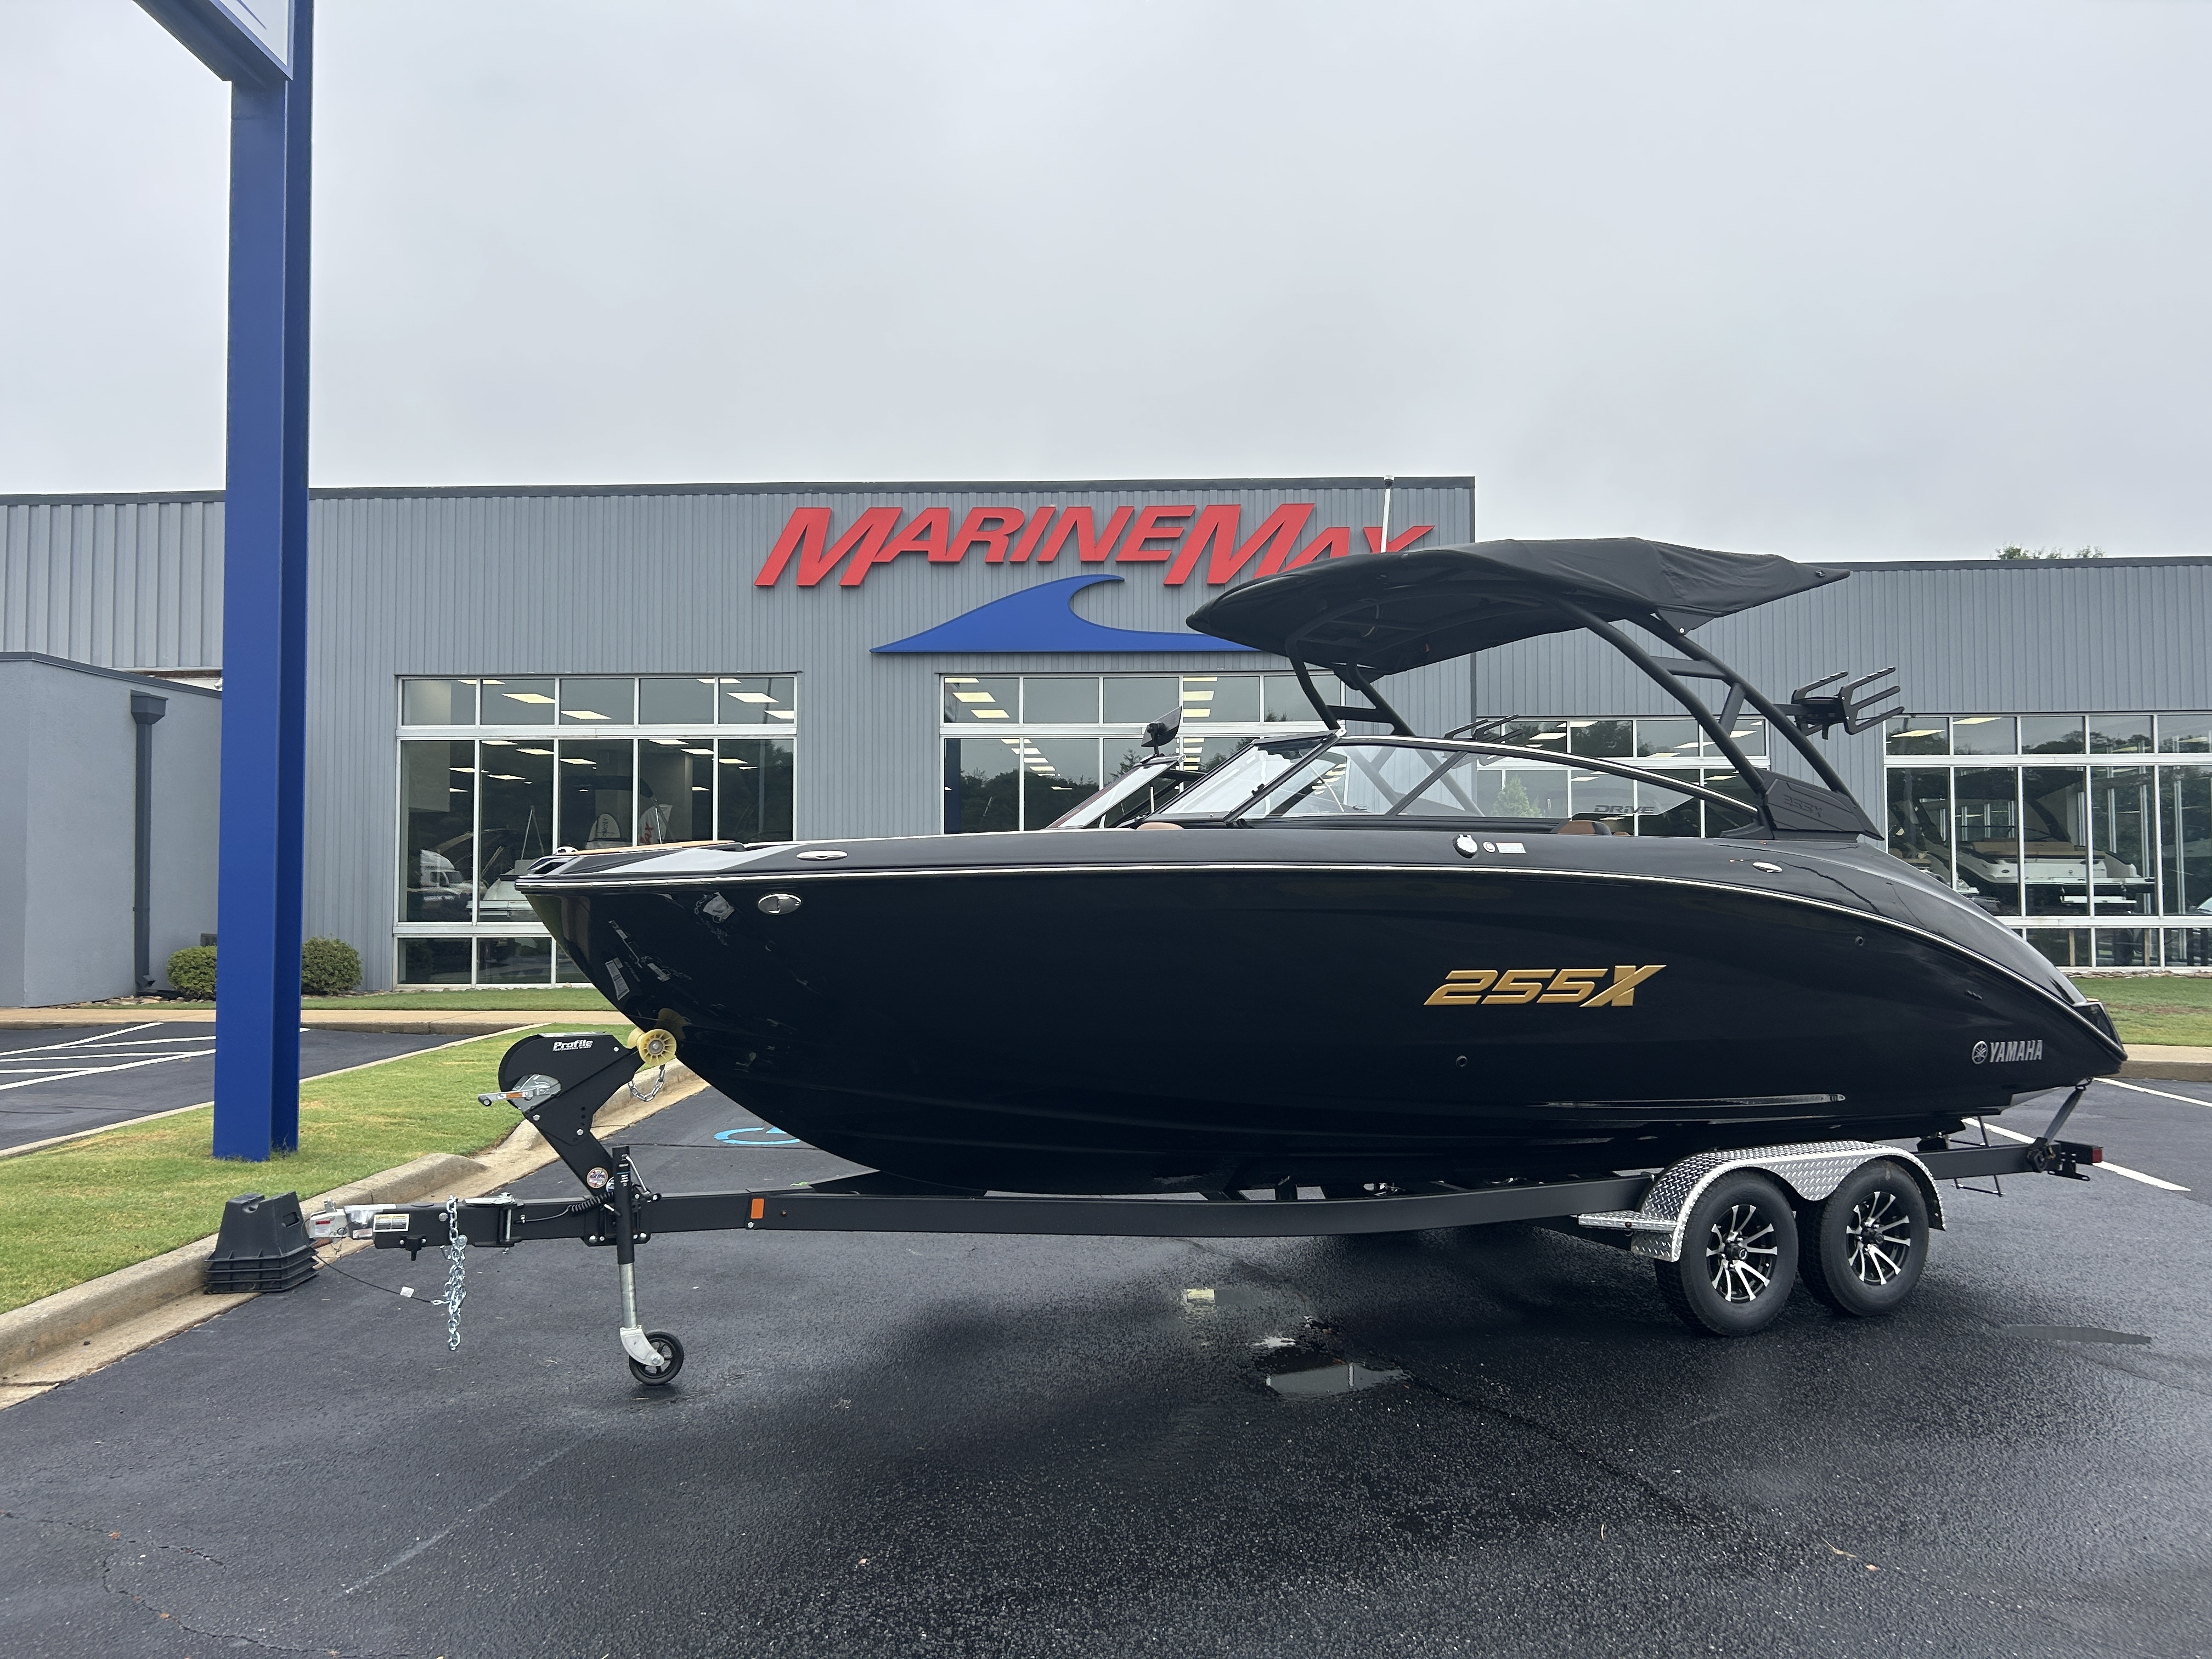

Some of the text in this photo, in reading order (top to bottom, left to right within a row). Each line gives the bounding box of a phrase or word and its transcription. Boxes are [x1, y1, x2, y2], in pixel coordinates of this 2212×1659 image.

[1423, 964, 1667, 1007] 255X
[553, 1039, 594, 1049] Profile
[1989, 1040, 2043, 1063] YAMAHA
